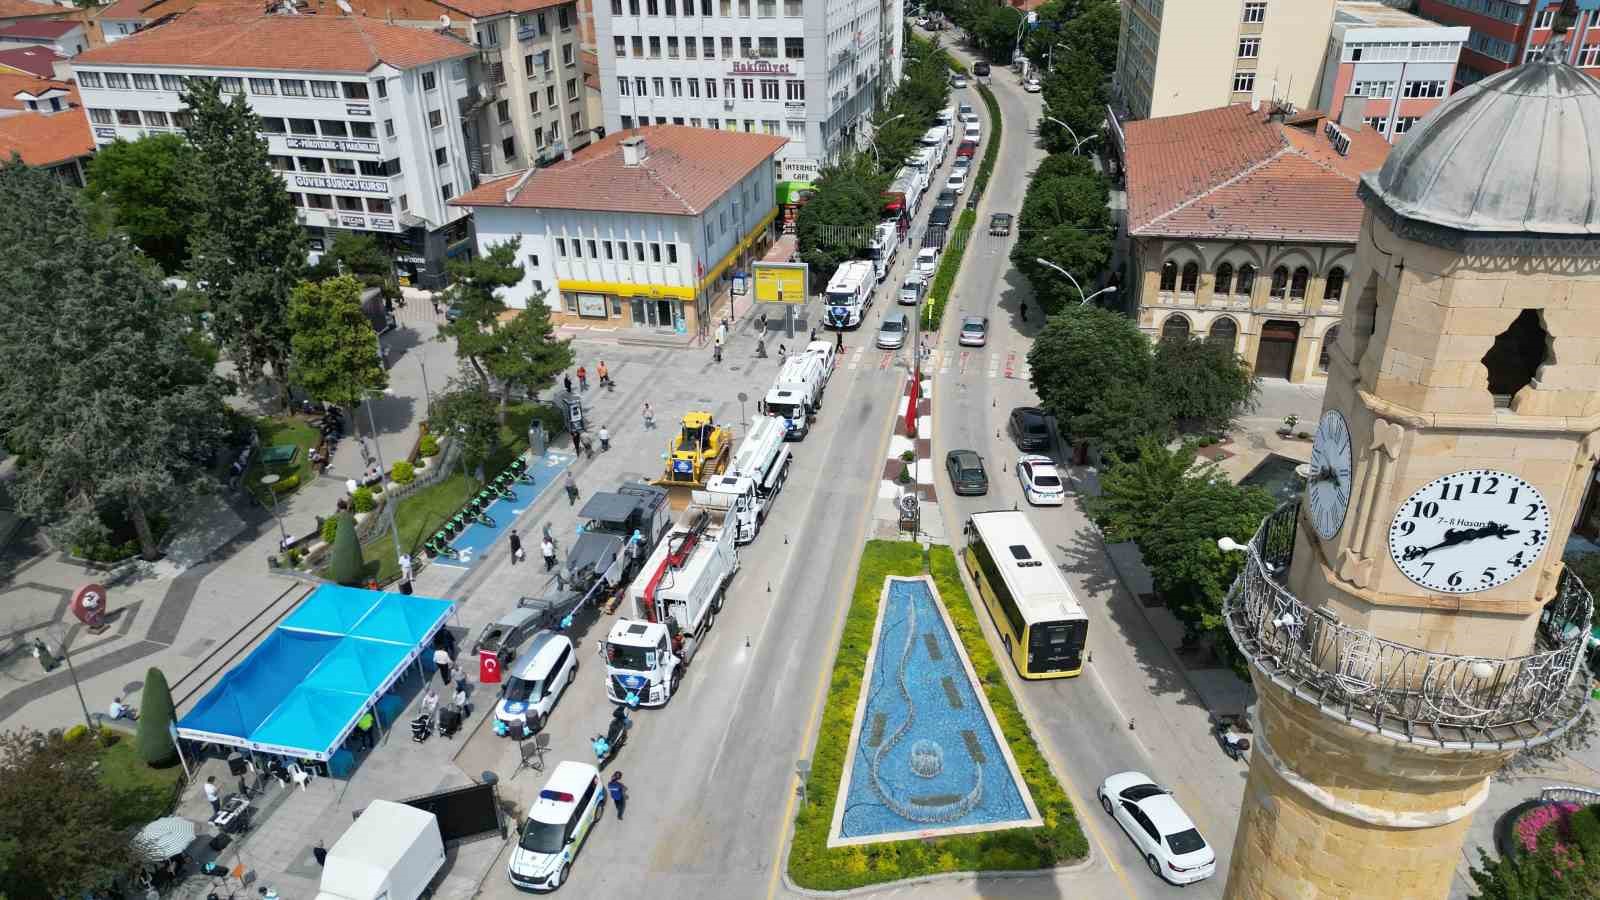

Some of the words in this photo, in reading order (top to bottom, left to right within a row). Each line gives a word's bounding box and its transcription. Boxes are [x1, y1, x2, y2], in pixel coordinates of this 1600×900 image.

[1439, 483, 1464, 501] 11
[1470, 476, 1499, 495] 12
[1507, 486, 1519, 504] 1
[1411, 501, 1439, 518] 10
[1522, 503, 1539, 521] 2
[1400, 520, 1416, 536] 9
[1523, 529, 1541, 546] 3
[1506, 551, 1524, 568] 4
[1420, 561, 1435, 578] 7
[1447, 570, 1465, 586] 6
[1480, 566, 1497, 583] 5
